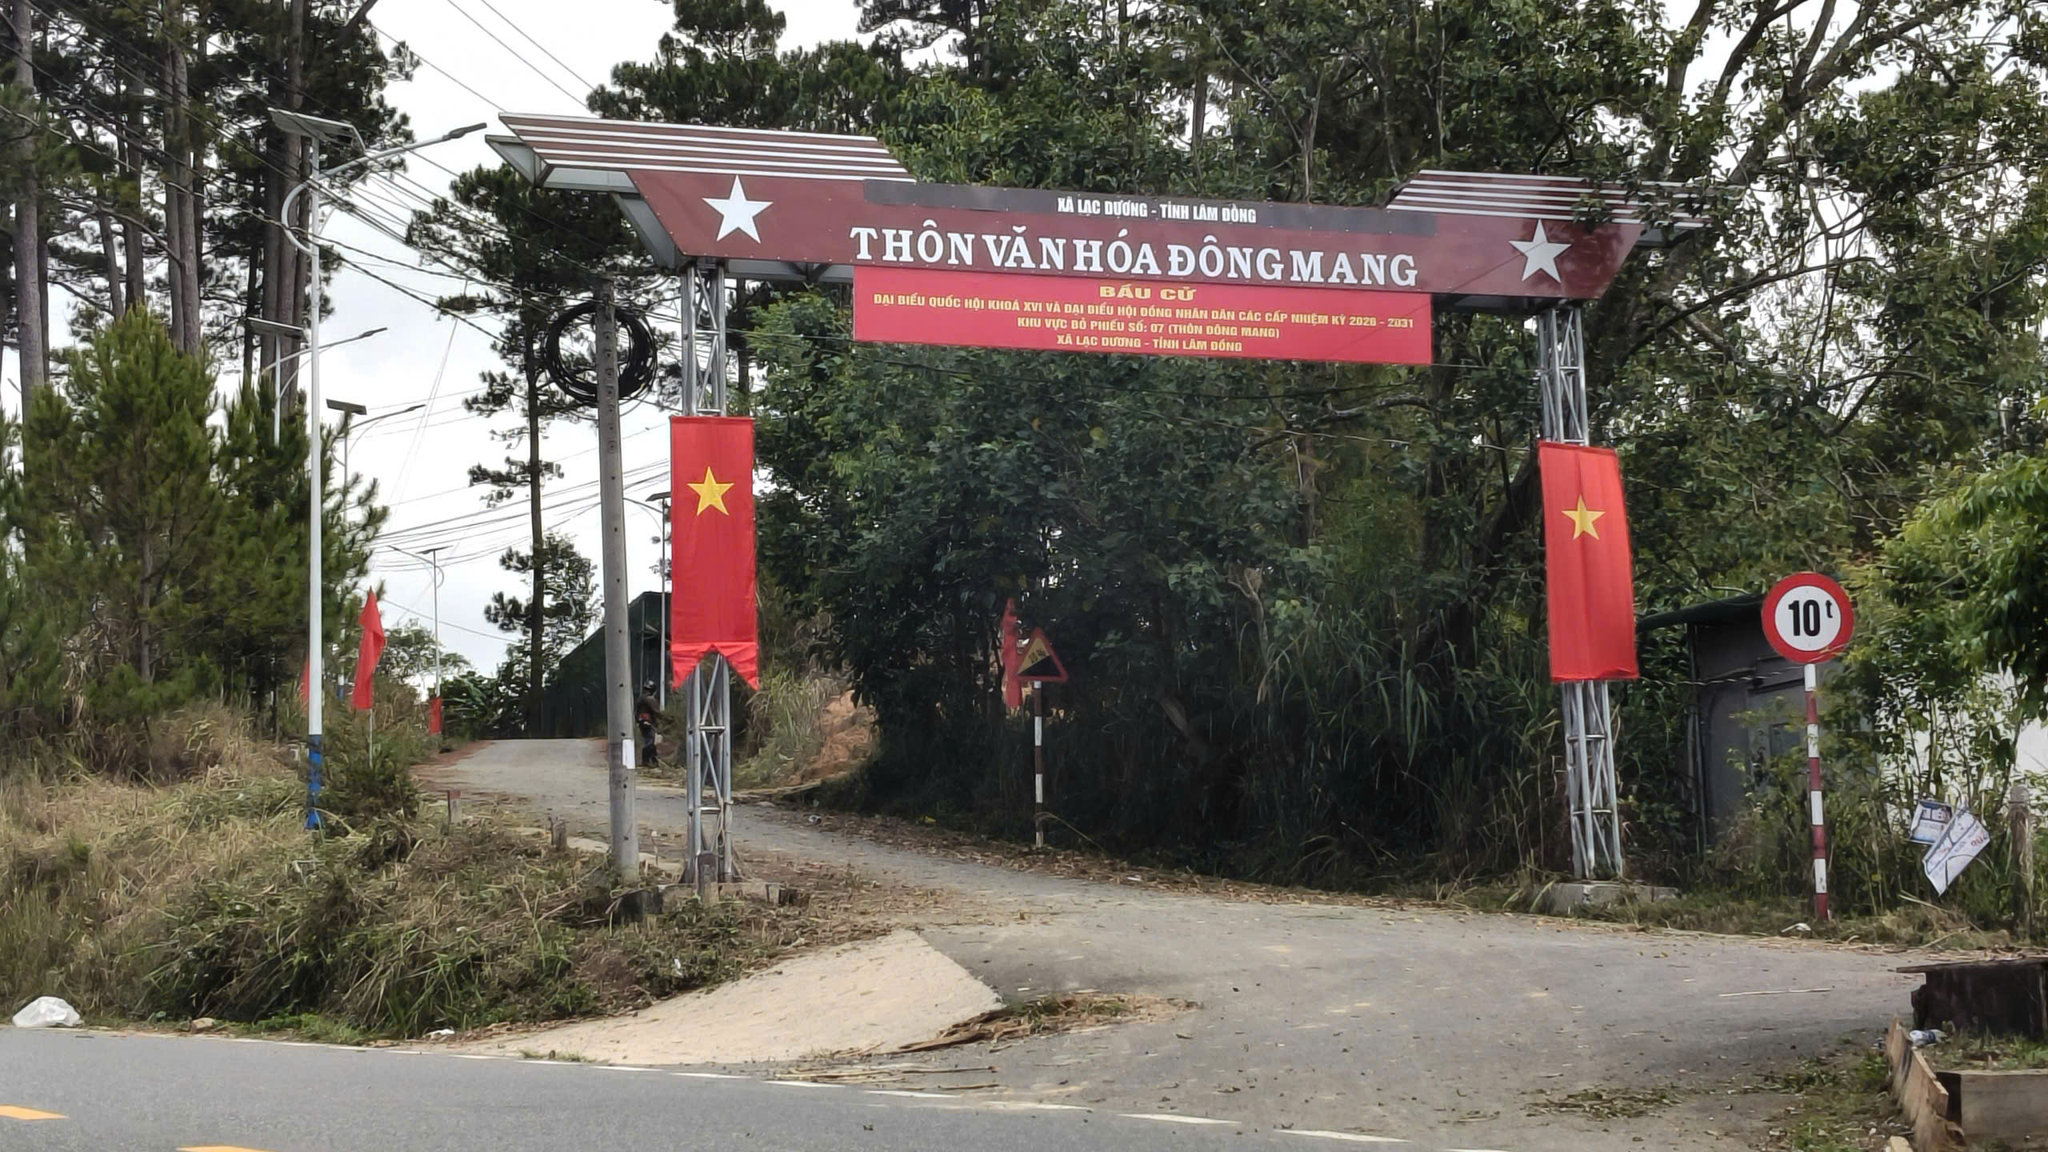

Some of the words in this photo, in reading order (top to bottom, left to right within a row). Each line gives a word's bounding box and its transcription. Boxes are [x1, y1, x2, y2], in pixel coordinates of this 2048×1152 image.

[1057, 196, 1074, 213] XÃ
[1077, 199, 1101, 216] LẠC
[1104, 200, 1148, 217] DƯƠNG
[1159, 201, 1189, 220] TỈNH
[1193, 203, 1218, 221] LÂM
[1222, 203, 1257, 224] ĐỒNG
[850, 219, 976, 266] THÔN
[982, 225, 1066, 271] VĂN
[1073, 228, 1162, 276] HÓA
[1167, 235, 1284, 281] ĐÔNG
[1289, 251, 1418, 287] MANG
[874, 294, 894, 306] ĐẠI
[929, 294, 961, 308] QUỐC
[964, 298, 985, 311] HỘI
[1023, 302, 1042, 312] XVI
[1046, 302, 1061, 313] VÀ
[1064, 304, 1084, 316] ĐẠI
[1117, 305, 1137, 318] HỘI
[1175, 308, 1208, 319] NHÂN
[1211, 309, 1235, 321] DÂN
[1238, 310, 1262, 322] CÁC
[1265, 310, 1288, 323] CẤP
[1291, 312, 1329, 326] NHIỆM
[1387, 318, 1414, 329] 2031
[1017, 317, 1041, 328] KHU
[1045, 318, 1068, 331] VỰC
[1071, 317, 1087, 330] BỎ
[1090, 318, 1125, 332] PHIẾU
[1128, 319, 1147, 333] SỐ:
[1150, 323, 1165, 333] 07
[1168, 322, 1203, 335] (THÔN
[1241, 327, 1280, 339] MANG)
[1076, 335, 1098, 348] LẠC
[1153, 336, 1179, 349] TỈNH
[1182, 338, 1207, 351] LÂM
